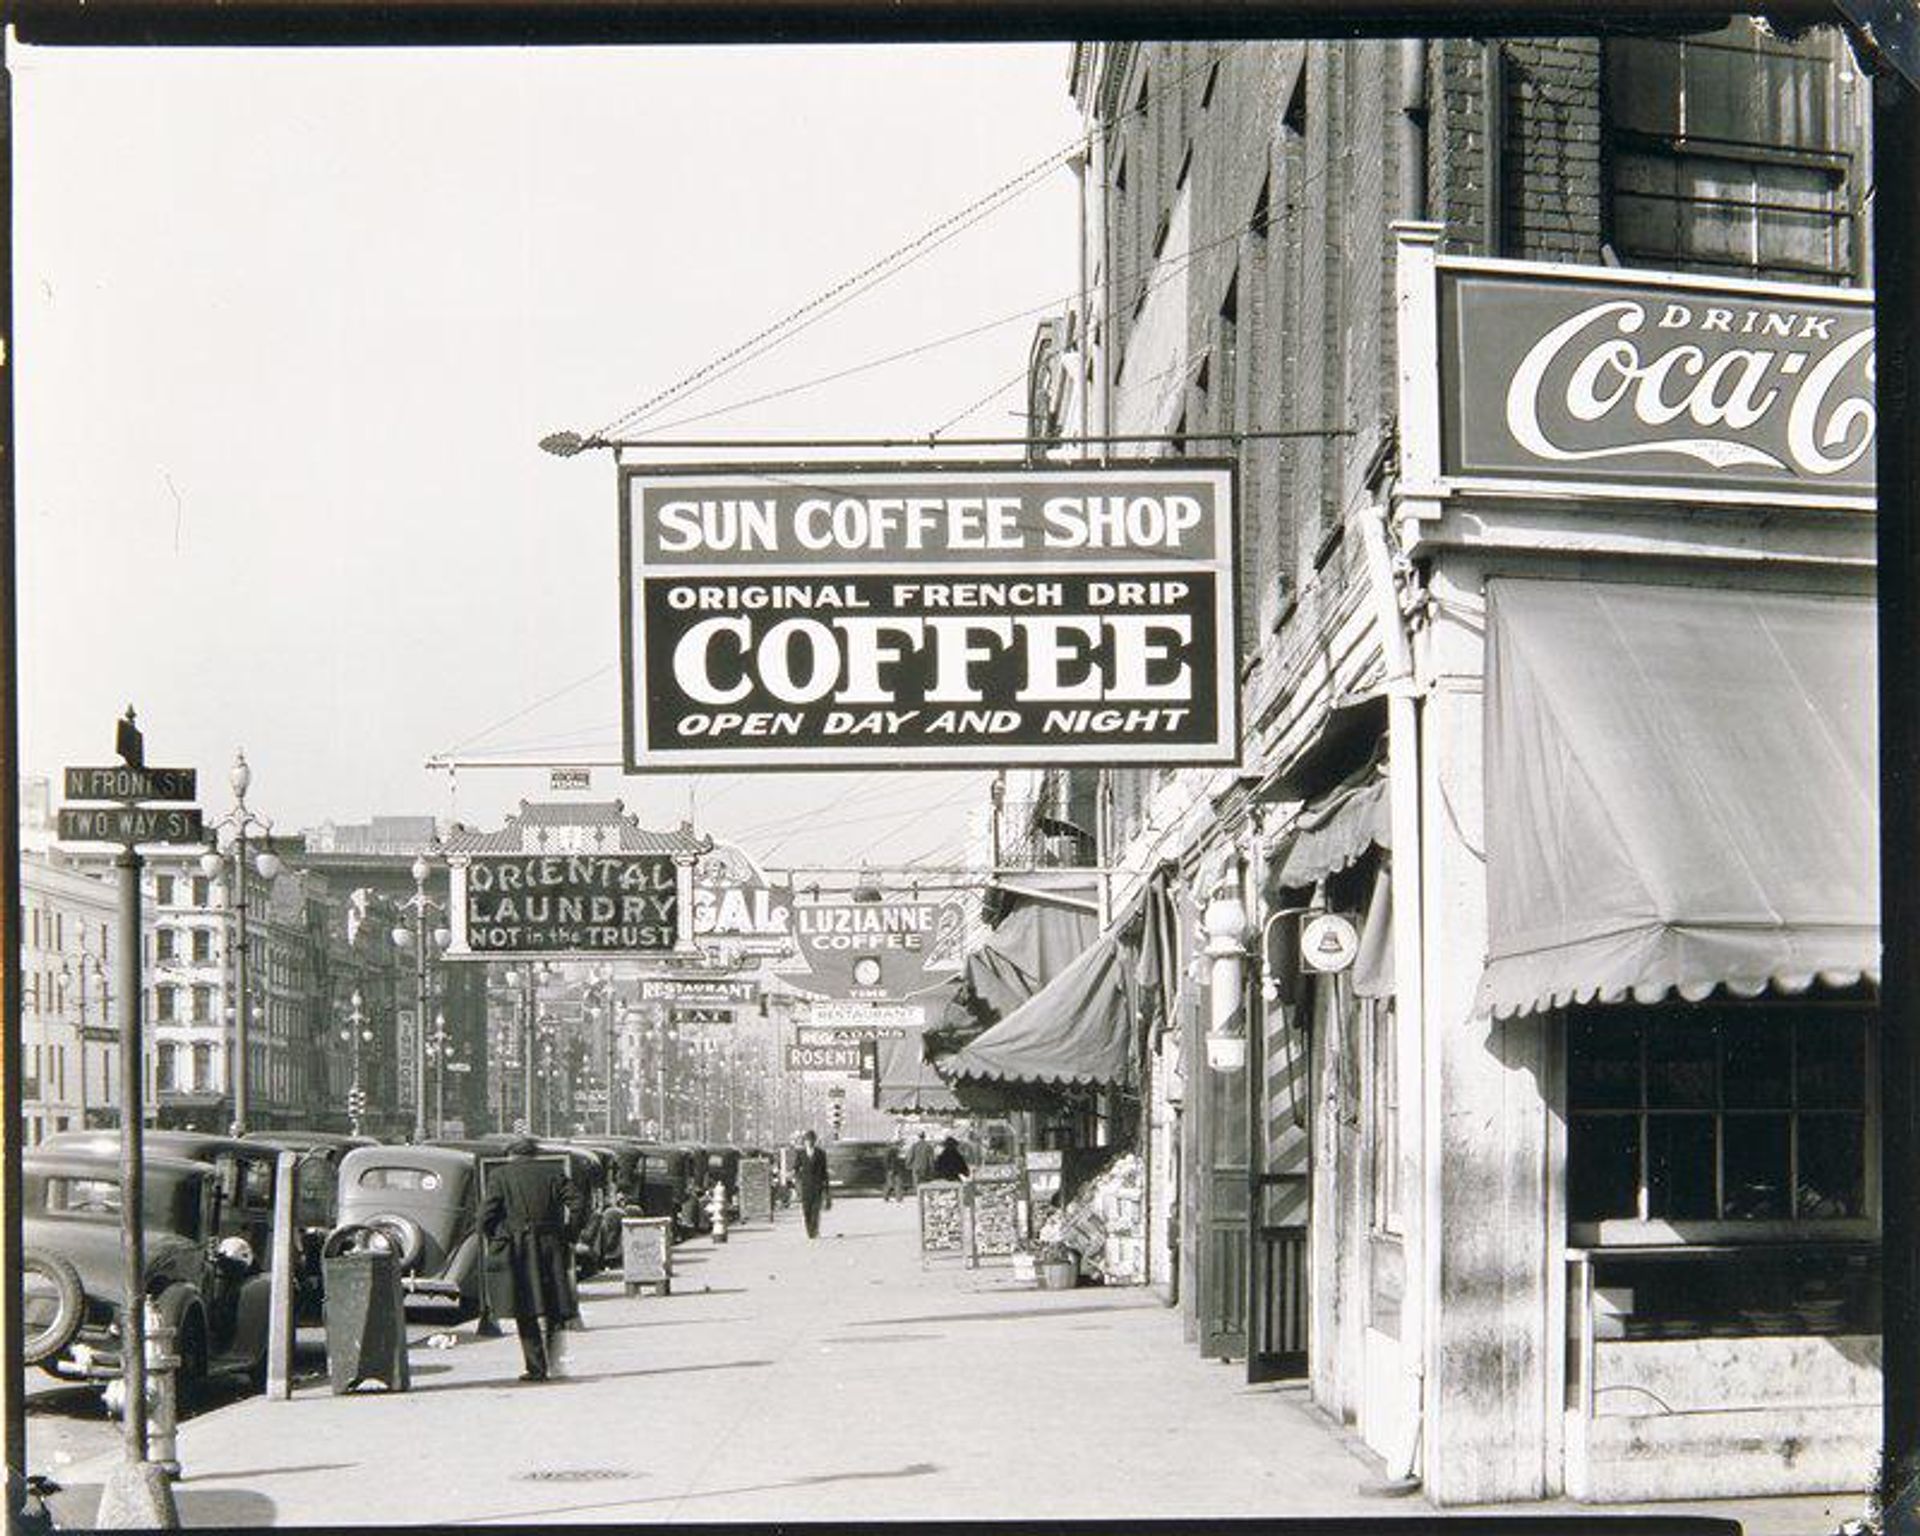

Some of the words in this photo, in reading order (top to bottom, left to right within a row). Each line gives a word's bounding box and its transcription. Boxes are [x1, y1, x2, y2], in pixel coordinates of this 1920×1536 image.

[1658, 304, 1838, 340] DRINK
[658, 501, 778, 551] SUN
[794, 498, 1024, 549] COFFEE
[1043, 496, 1202, 547] SHOP
[667, 585, 870, 609] ORIGINAL
[893, 583, 1062, 607] FRENCH
[1088, 581, 1190, 605] DRIP
[673, 614, 1192, 703] COFFEE
[677, 712, 805, 736] OPEN
[823, 711, 920, 736] DAY
[925, 711, 1021, 735] AND
[1044, 708, 1189, 734] NIGHT
[71, 771, 84, 795] N
[91, 771, 153, 796] FRONT
[164, 772, 191, 794] ST
[64, 811, 107, 837] TWO
[121, 811, 158, 836] WAY
[168, 812, 191, 837] ST
[469, 856, 675, 892] ORIENTAL
[470, 895, 676, 923] LAUNDRY
[799, 906, 933, 933] LUZIANNE
[471, 927, 523, 947] NOT
[526, 927, 543, 945] in
[549, 927, 580, 945] the
[587, 926, 674, 947] TRUST
[811, 934, 922, 950] COFFEE
[642, 982, 754, 1000] RESTAURANT
